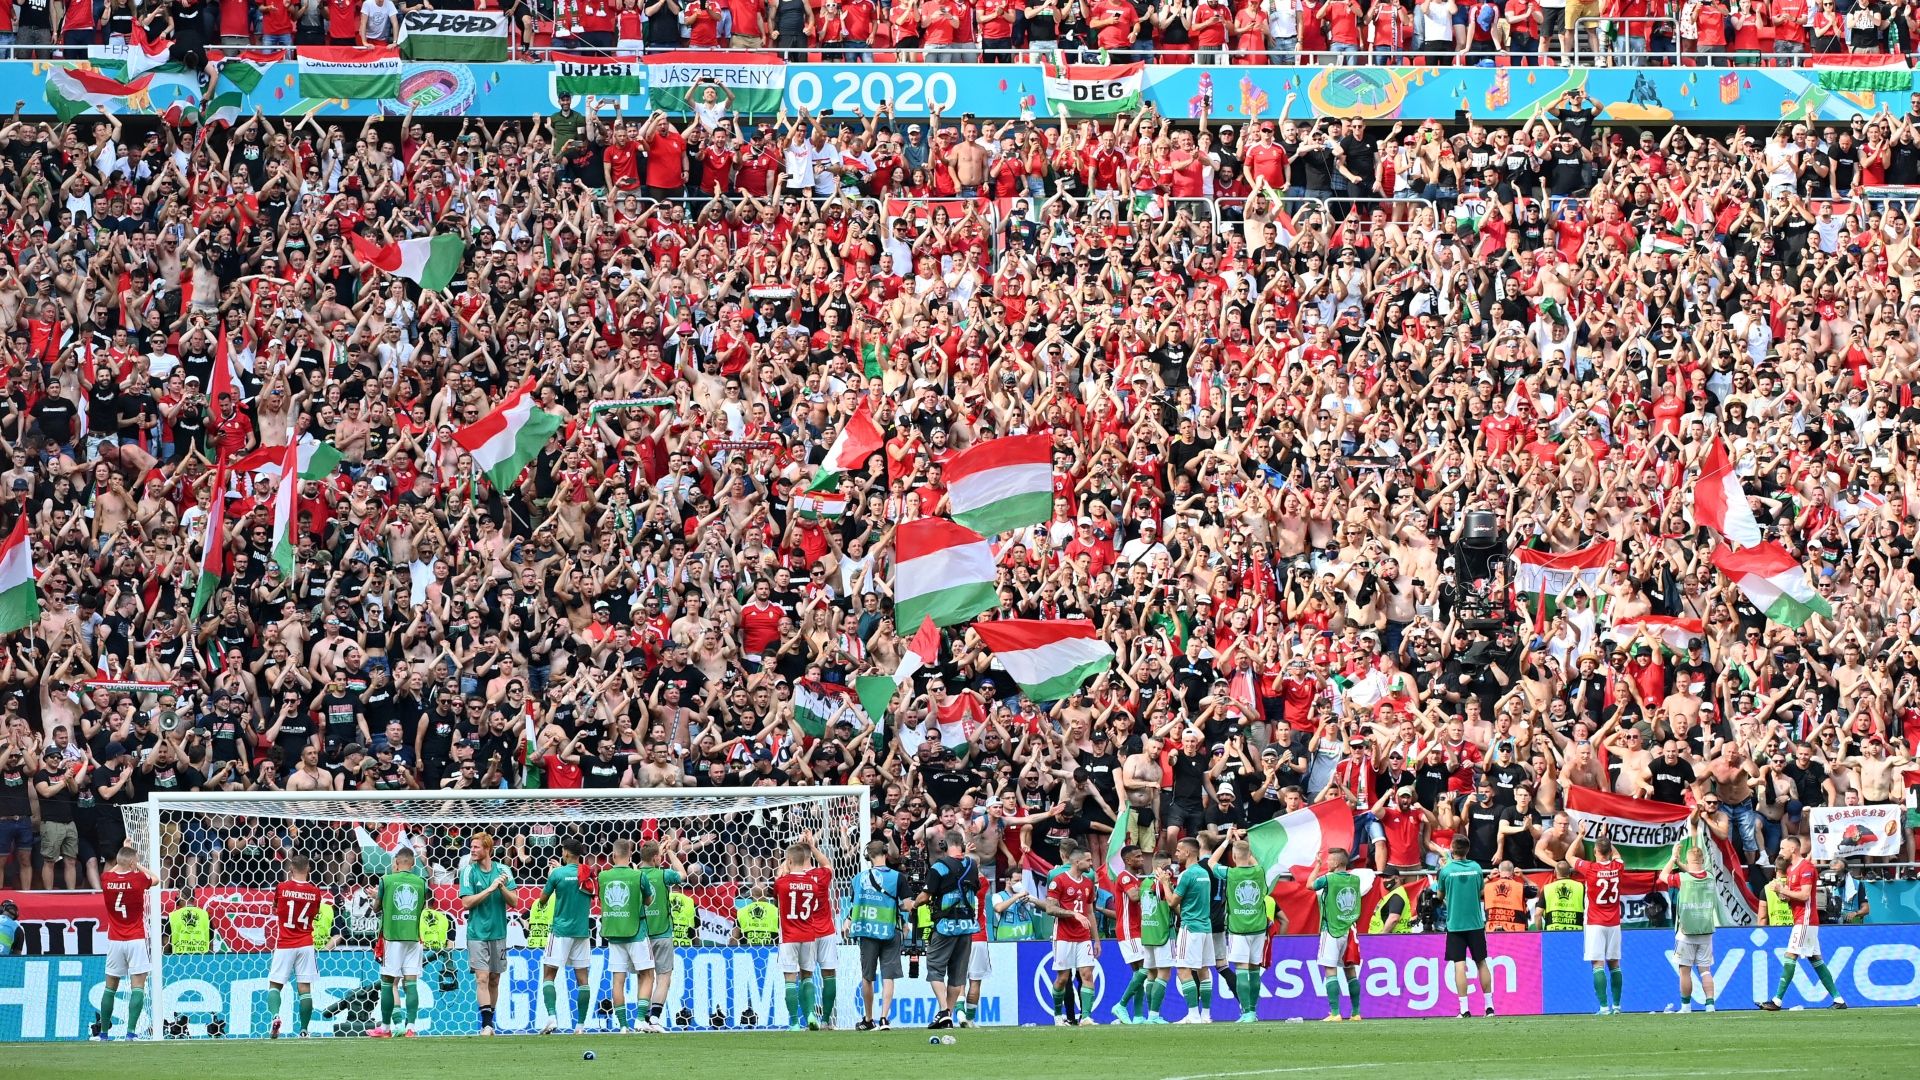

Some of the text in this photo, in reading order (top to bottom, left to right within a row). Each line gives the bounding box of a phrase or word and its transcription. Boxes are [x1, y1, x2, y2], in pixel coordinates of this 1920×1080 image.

[404, 11, 497, 33] SZEGED
[661, 65, 774, 84] JÁSZBERÉNY
[824, 72, 956, 113] 2020
[1073, 77, 1125, 101] DÉG
[1578, 817, 1688, 844] ZÉKESFEHÉRV
[106, 882, 126, 890] SZALAI
[1596, 877, 1620, 905] 23
[114, 892, 127, 918] 4
[283, 900, 311, 930] 14
[786, 891, 814, 920] 13
[859, 905, 878, 920] HB
[1073, 900, 1084, 913] 21
[1012, 925, 1027, 937] TV
[1664, 927, 1920, 1003] vivo
[496, 953, 788, 1029] GAZROM
